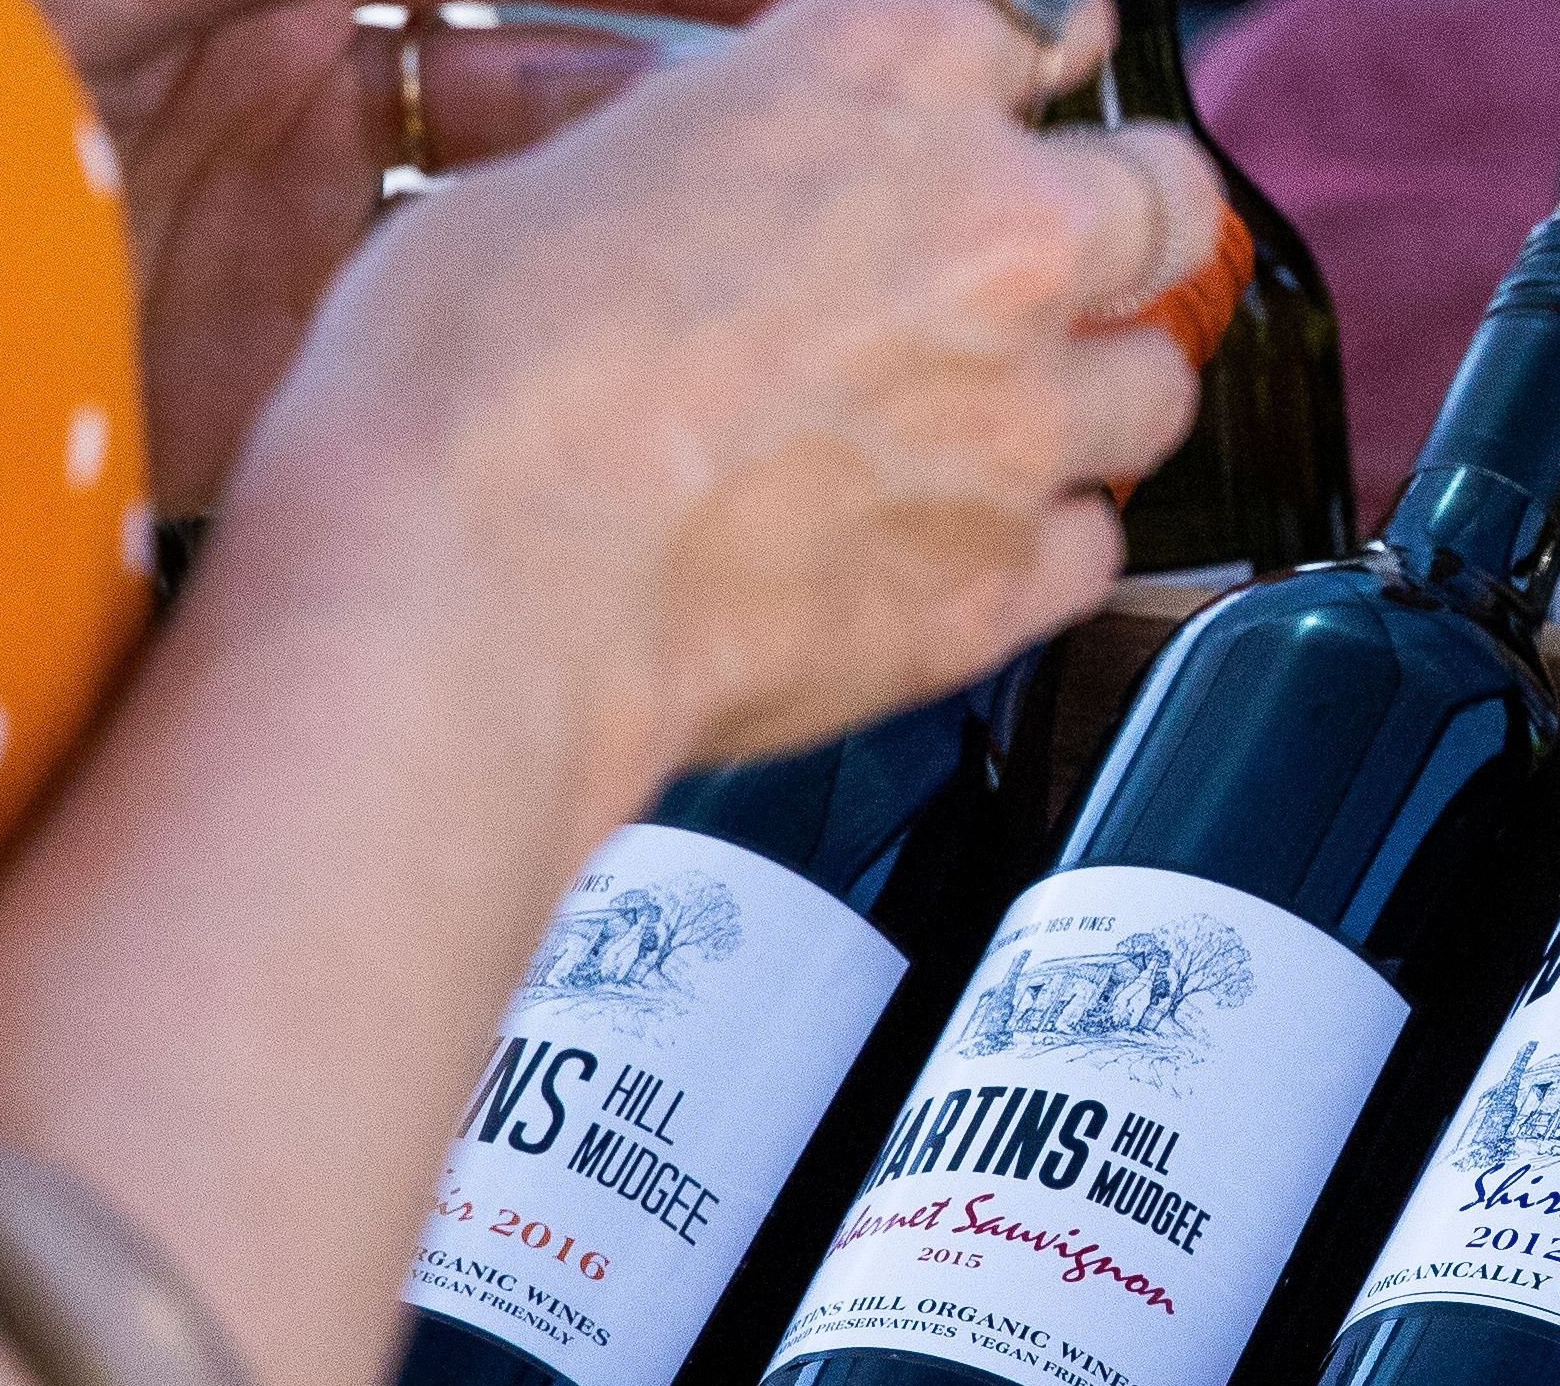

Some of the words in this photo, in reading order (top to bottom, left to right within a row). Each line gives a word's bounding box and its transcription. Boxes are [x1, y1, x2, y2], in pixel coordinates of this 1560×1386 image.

[1077, 915, 1117, 933] VINES
[457, 1035, 599, 1155] NS
[600, 1064, 686, 1146] HILL
[1111, 1112, 1181, 1177] HILL
[566, 1121, 721, 1247] MUDGEE
[1087, 1165, 1212, 1256] MUDGEE
[488, 1207, 611, 1282] 2016
[916, 1246, 985, 1270] 2015
[951, 1192, 1175, 1316] Sauvignon
[415, 1247, 519, 1293] RGANIC
[525, 1284, 612, 1347] WINES
[1366, 1260, 1553, 1298] ORGANICALLY
[477, 1289, 577, 1347] FRIENDLY
[814, 1316, 959, 1340] PRESERVATIVES
[969, 1331, 1040, 1368] VEGAN
[847, 1295, 908, 1313] HILL
[915, 1297, 1053, 1350] ORGANIC
